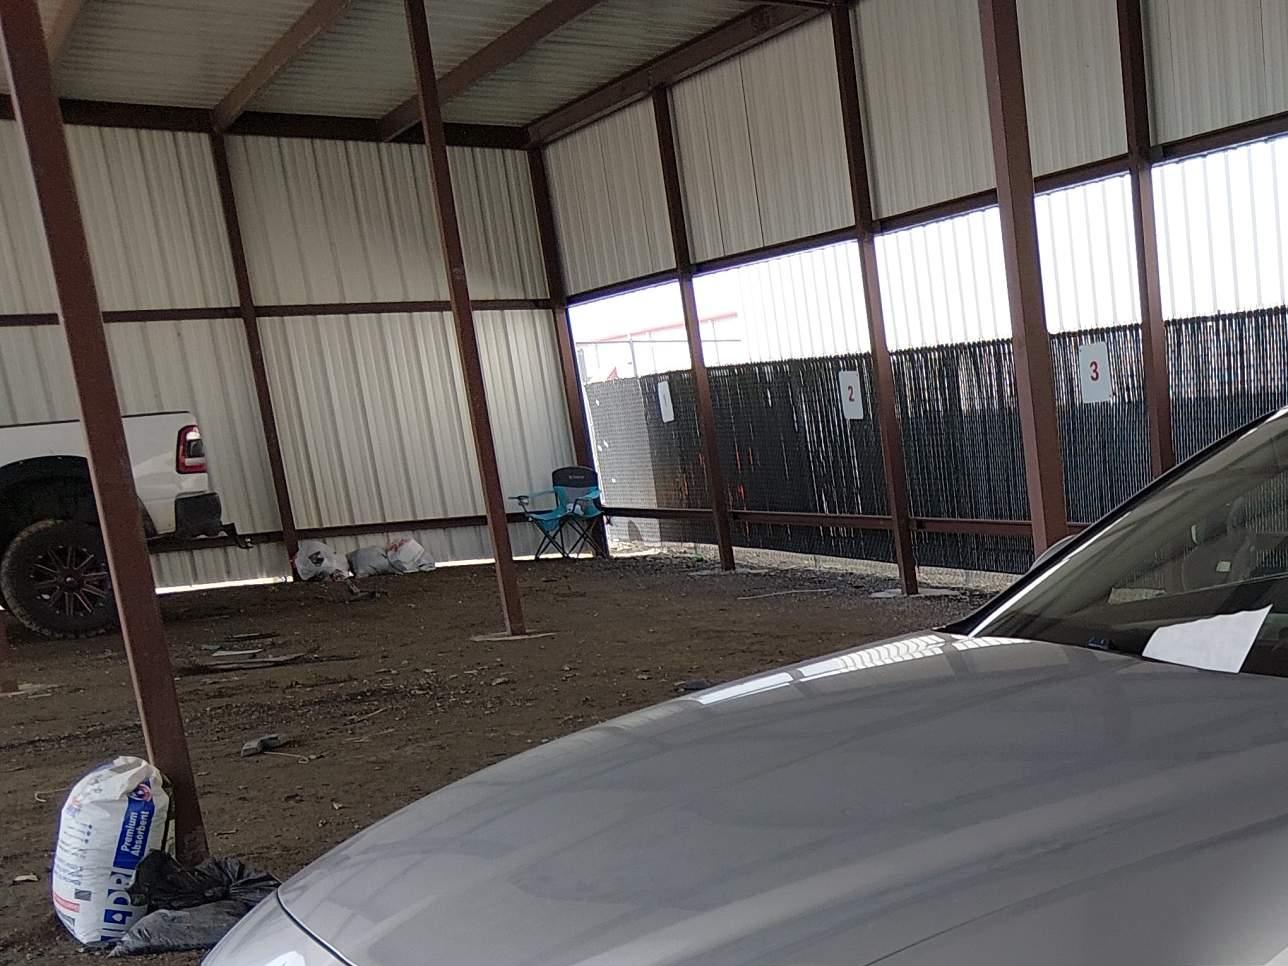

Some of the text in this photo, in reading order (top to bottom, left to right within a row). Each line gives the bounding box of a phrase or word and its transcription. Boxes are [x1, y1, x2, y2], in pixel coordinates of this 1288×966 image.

[1089, 360, 1100, 381] 3
[847, 385, 855, 402] 2
[120, 811, 138, 852] Premium
[130, 810, 150, 857] Absorbent
